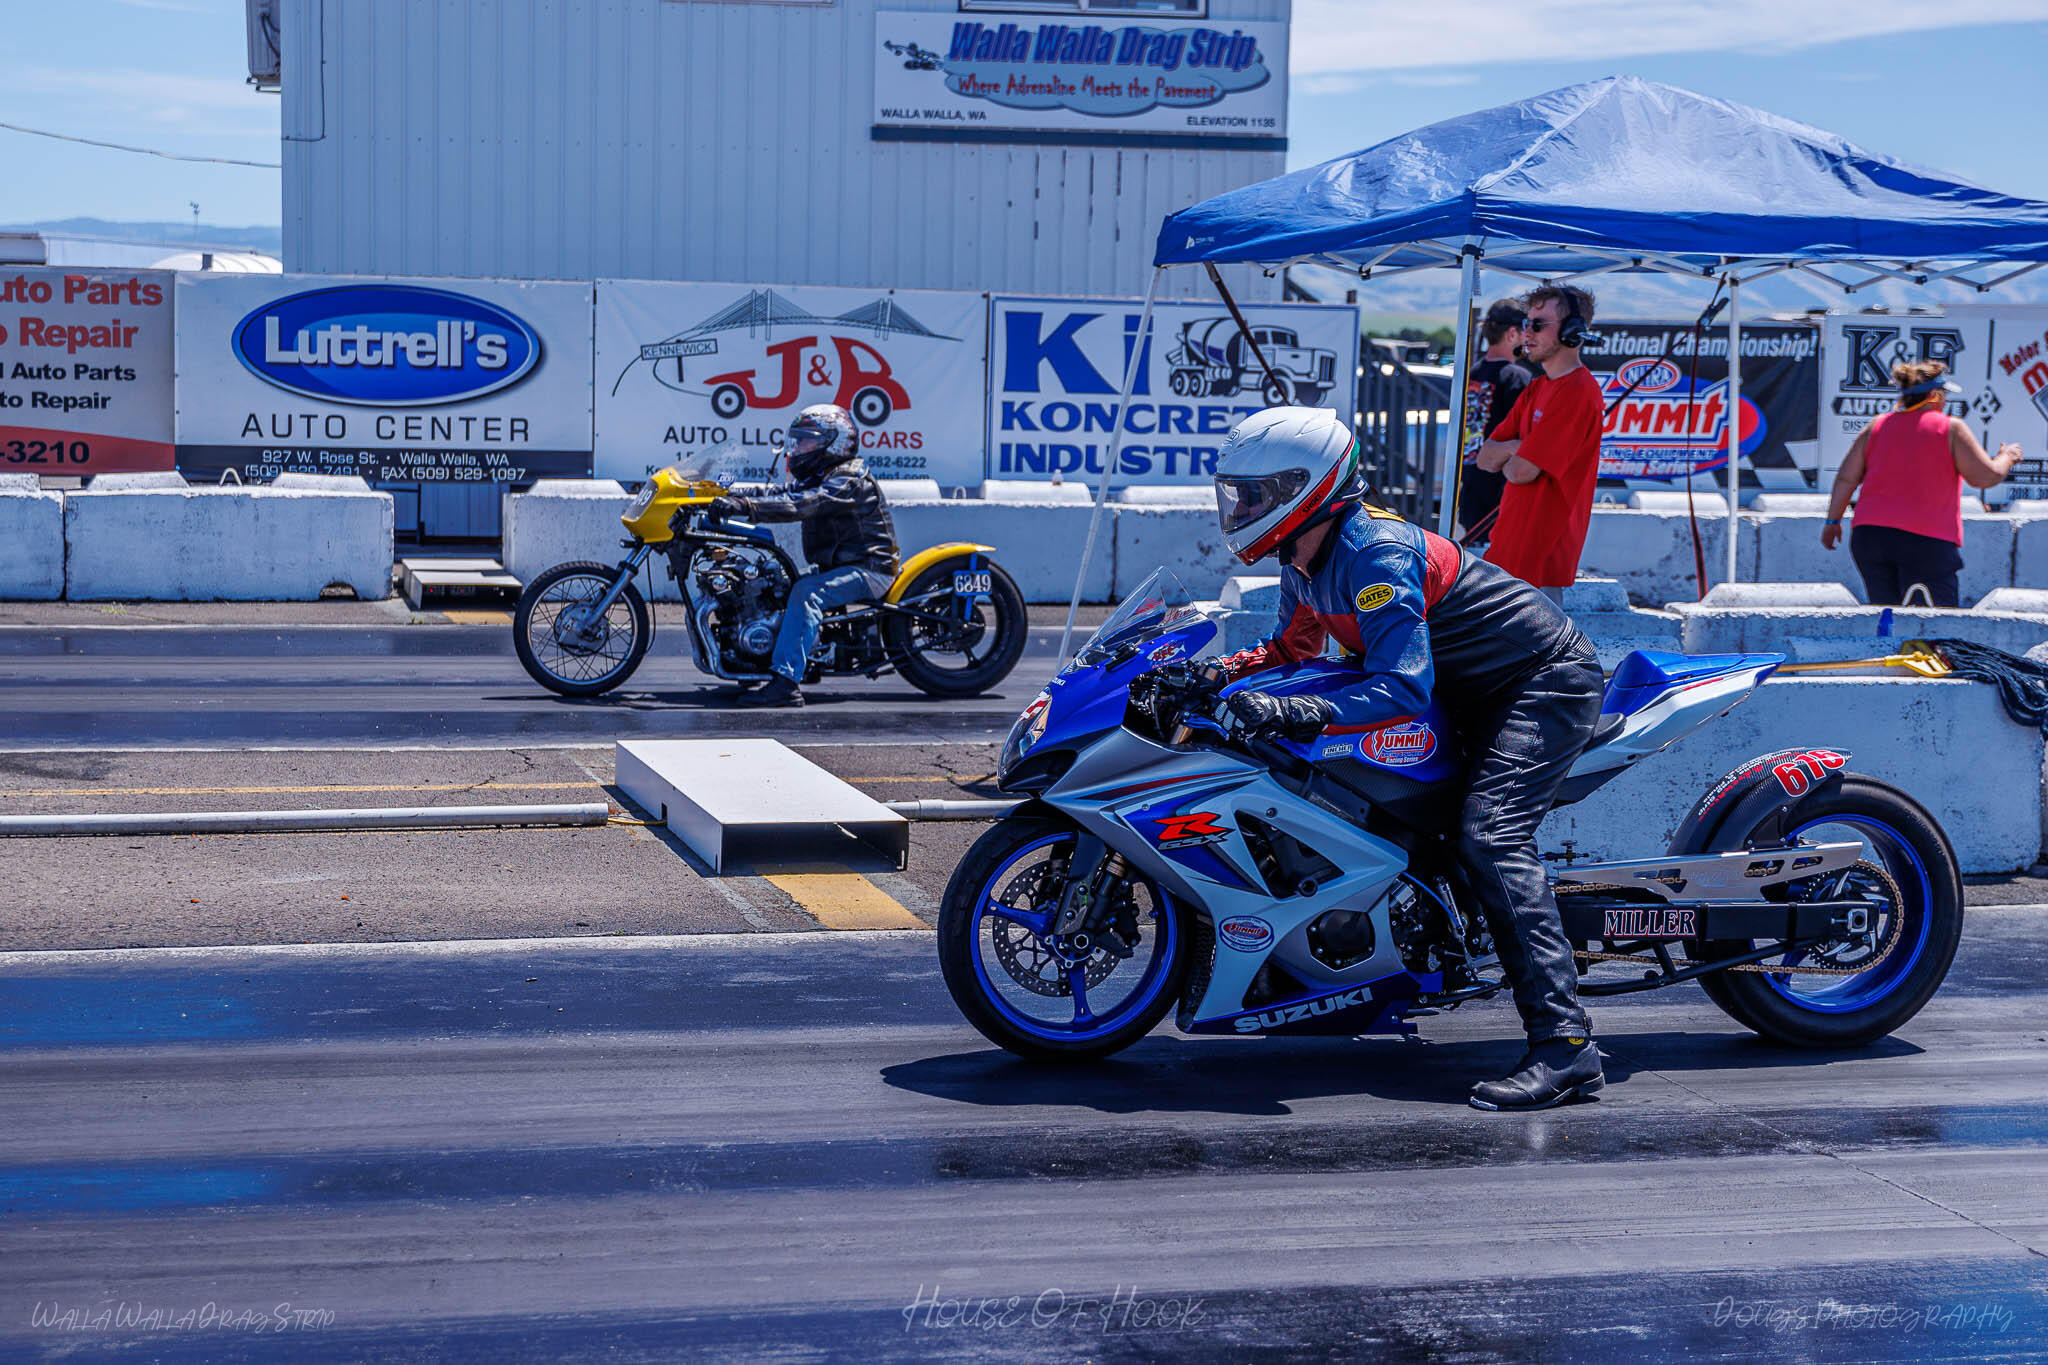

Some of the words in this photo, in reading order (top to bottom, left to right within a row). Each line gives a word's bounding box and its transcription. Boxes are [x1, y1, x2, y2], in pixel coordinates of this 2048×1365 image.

[949, 22, 1033, 63] Walla
[1033, 25, 1115, 66] Walla
[1116, 27, 1187, 72] Drag
[1186, 28, 1257, 73] Strip
[958, 73, 1001, 94] Where
[1006, 73, 1077, 98] Adrenaline
[1081, 75, 1123, 97] Meets
[1127, 76, 1150, 98] the
[1153, 76, 1218, 101] Pavement
[881, 108, 920, 119] WALLA
[923, 109, 966, 121] WALLA,
[968, 110, 987, 121] WA
[1186, 116, 1249, 127] ELEVATION
[64, 274, 164, 306] Parts
[19, 317, 140, 355] Repair
[265, 315, 508, 369] Luttrell's
[643, 341, 714, 358] KENNEWICK
[1003, 311, 1154, 396] Ki
[11, 362, 67, 380] Auto
[74, 363, 137, 381] Parts
[1625, 361, 1675, 390] NHRA
[31, 391, 112, 413] Repair
[241, 413, 347, 439] AUTO
[376, 415, 529, 442] CENTER
[663, 426, 728, 445] AUTO
[742, 427, 785, 446] LLC
[860, 430, 924, 449] CARS
[262, 450, 292, 463] 927
[297, 450, 313, 463] W.
[320, 451, 354, 464] Rose
[359, 452, 379, 465] St.
[400, 452, 436, 465] Walla
[440, 453, 481, 467] Walla,
[485, 453, 510, 466] WA
[866, 455, 927, 468] 582-6222
[1000, 443, 1219, 475] INDUSTR
[381, 466, 407, 480] FAX
[411, 467, 450, 480] (509)
[454, 468, 526, 481] 529-1097
[954, 573, 992, 593] 6849
[1359, 588, 1391, 607] BATES
[1771, 749, 1847, 798] 615
[1603, 909, 1697, 937] MILLER
[1233, 986, 1374, 1034] SUZUKI
